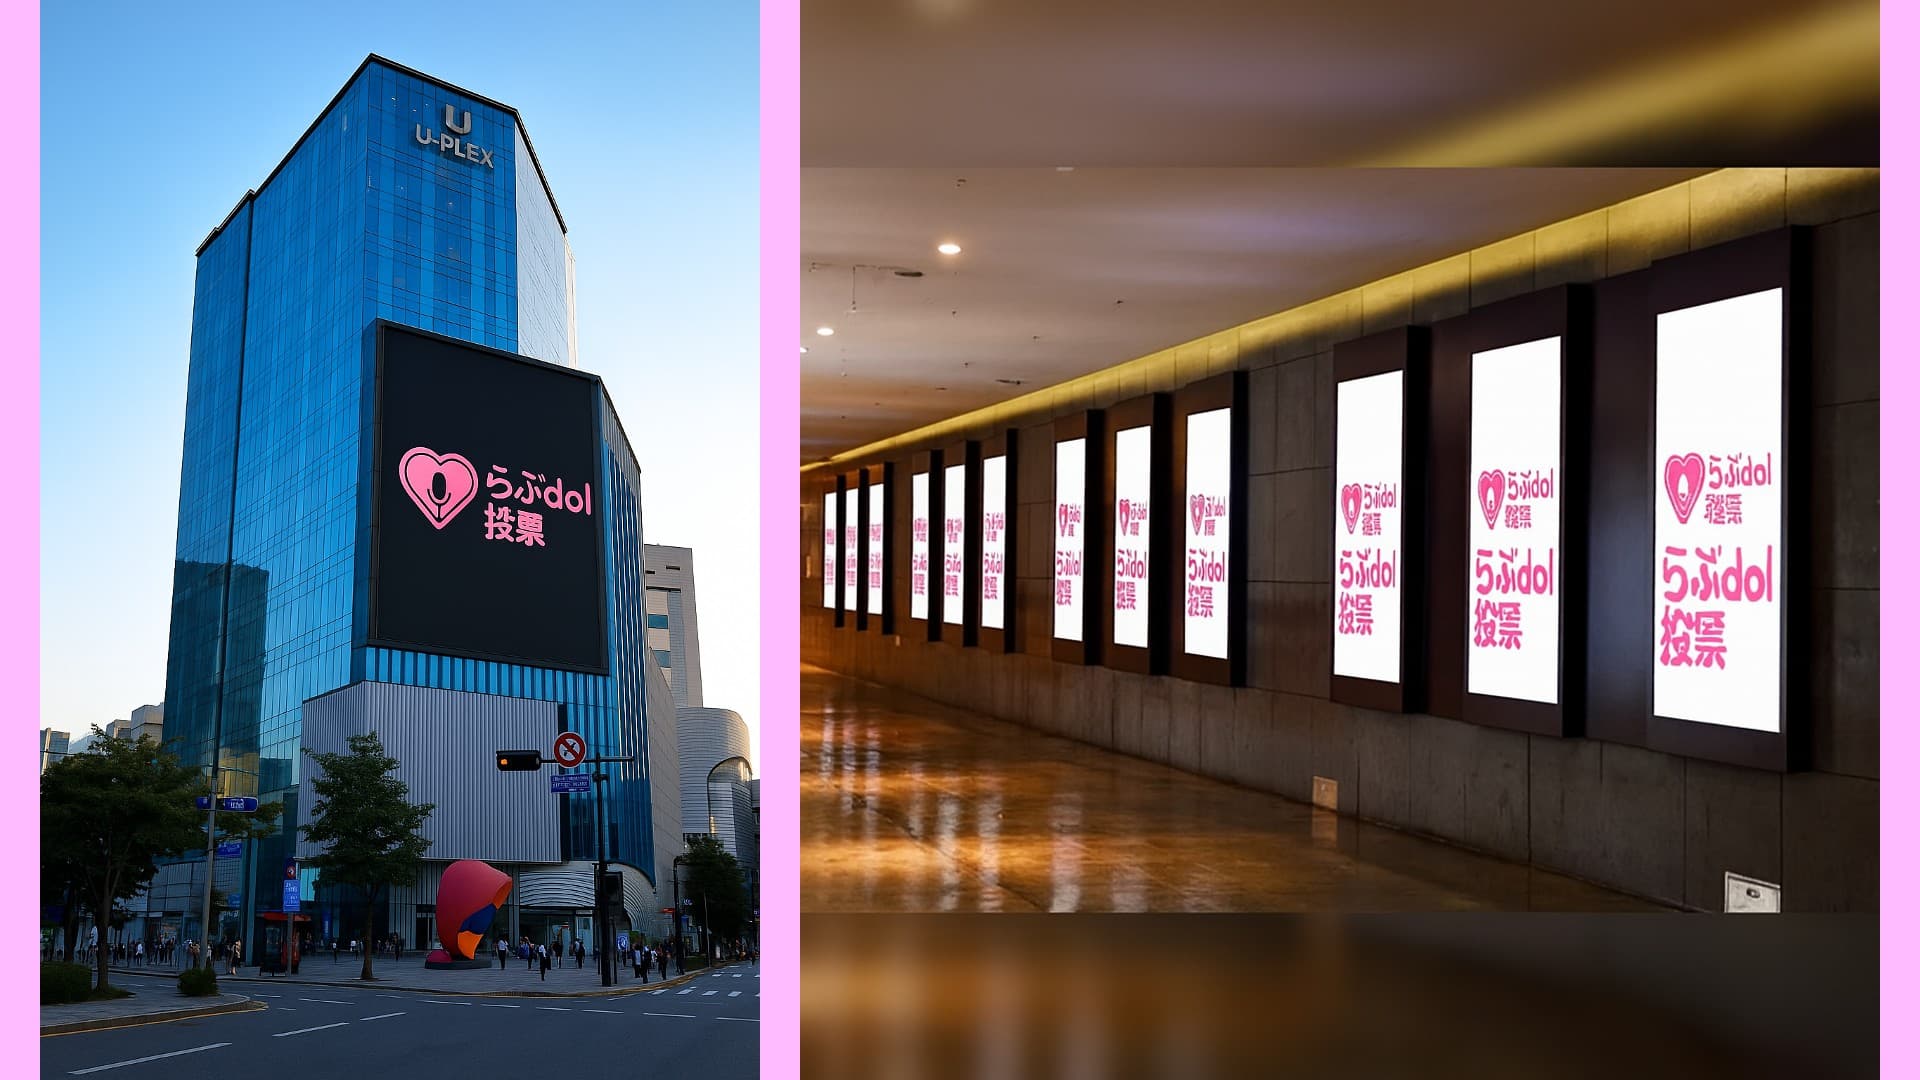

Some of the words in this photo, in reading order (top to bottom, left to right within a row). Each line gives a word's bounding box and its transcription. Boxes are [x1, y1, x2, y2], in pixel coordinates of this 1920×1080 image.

[446, 103, 472, 134] U
[415, 122, 494, 169] U-PLEX
[485, 464, 593, 516] らぶdol
[484, 501, 546, 547] 投票
[1339, 549, 1396, 590] らぶdol
[1475, 548, 1554, 596] らぶdol
[1662, 545, 1773, 603] らぶdol
